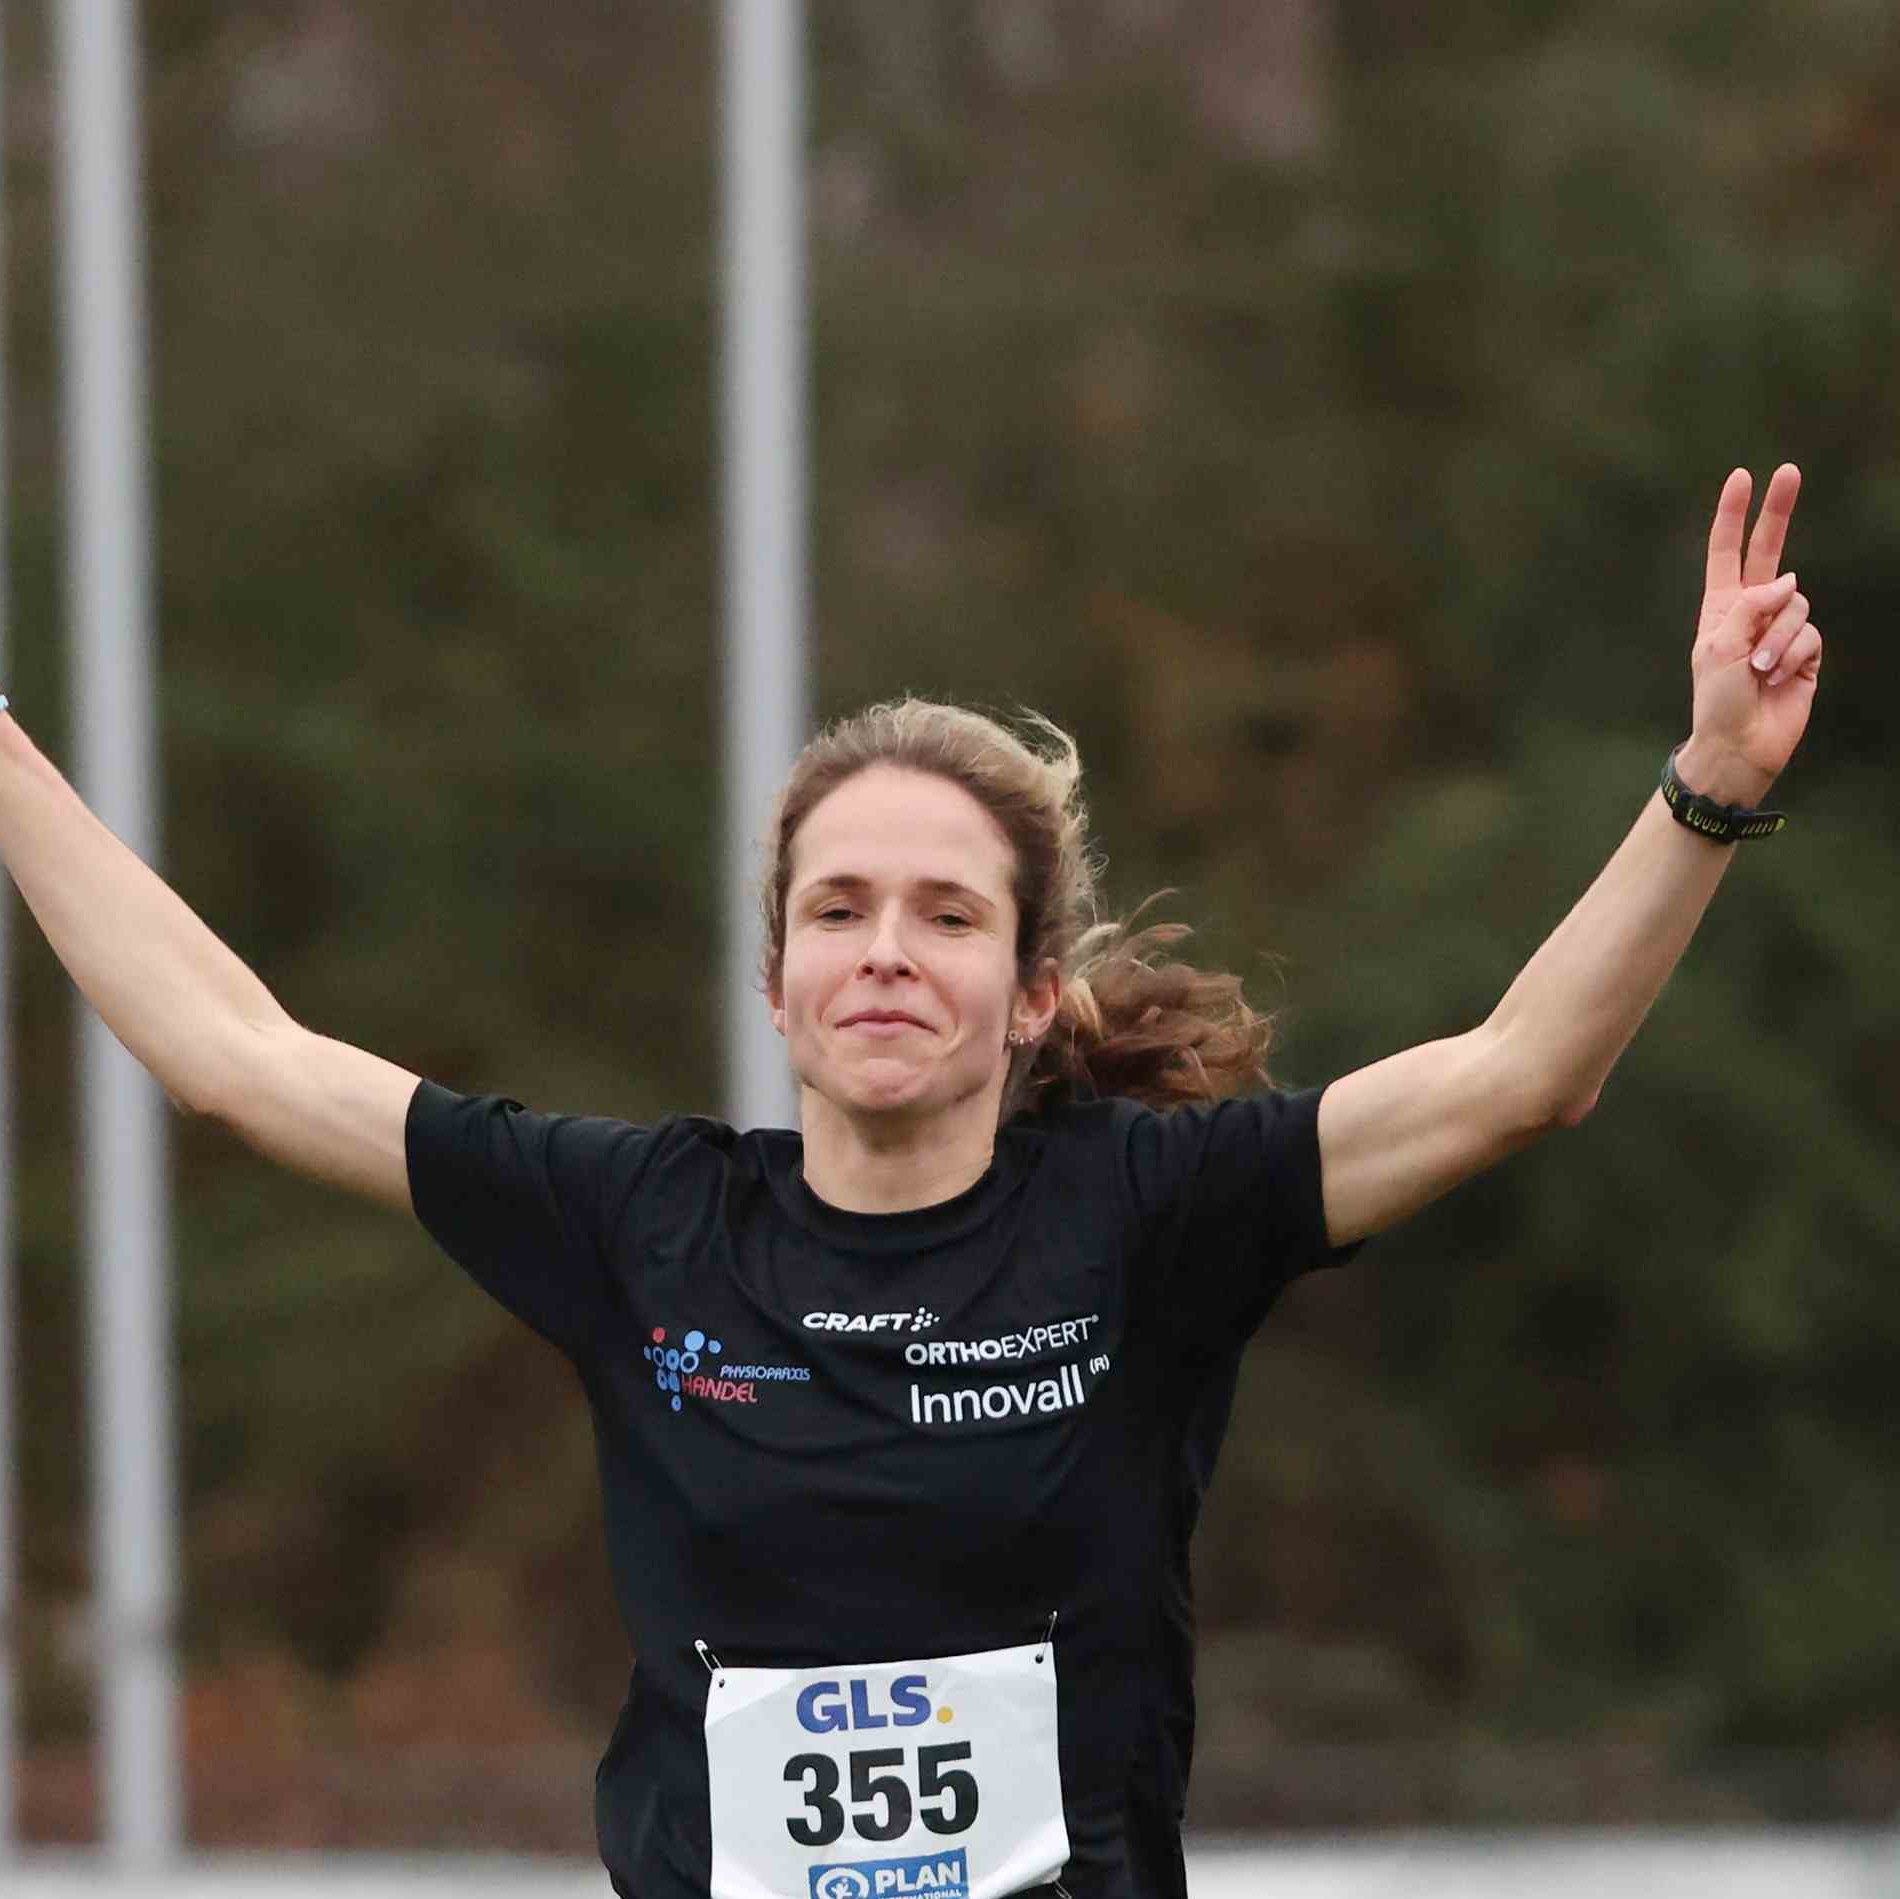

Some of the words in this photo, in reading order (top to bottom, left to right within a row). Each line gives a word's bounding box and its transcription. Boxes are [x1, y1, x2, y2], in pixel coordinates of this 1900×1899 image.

[802, 1312, 912, 1332] CRAFT
[680, 1373, 758, 1404] HANDEL
[910, 1363, 1085, 1424] Innovall
[783, 1741, 980, 1847] 355
[874, 1860, 962, 1895] PLAN
